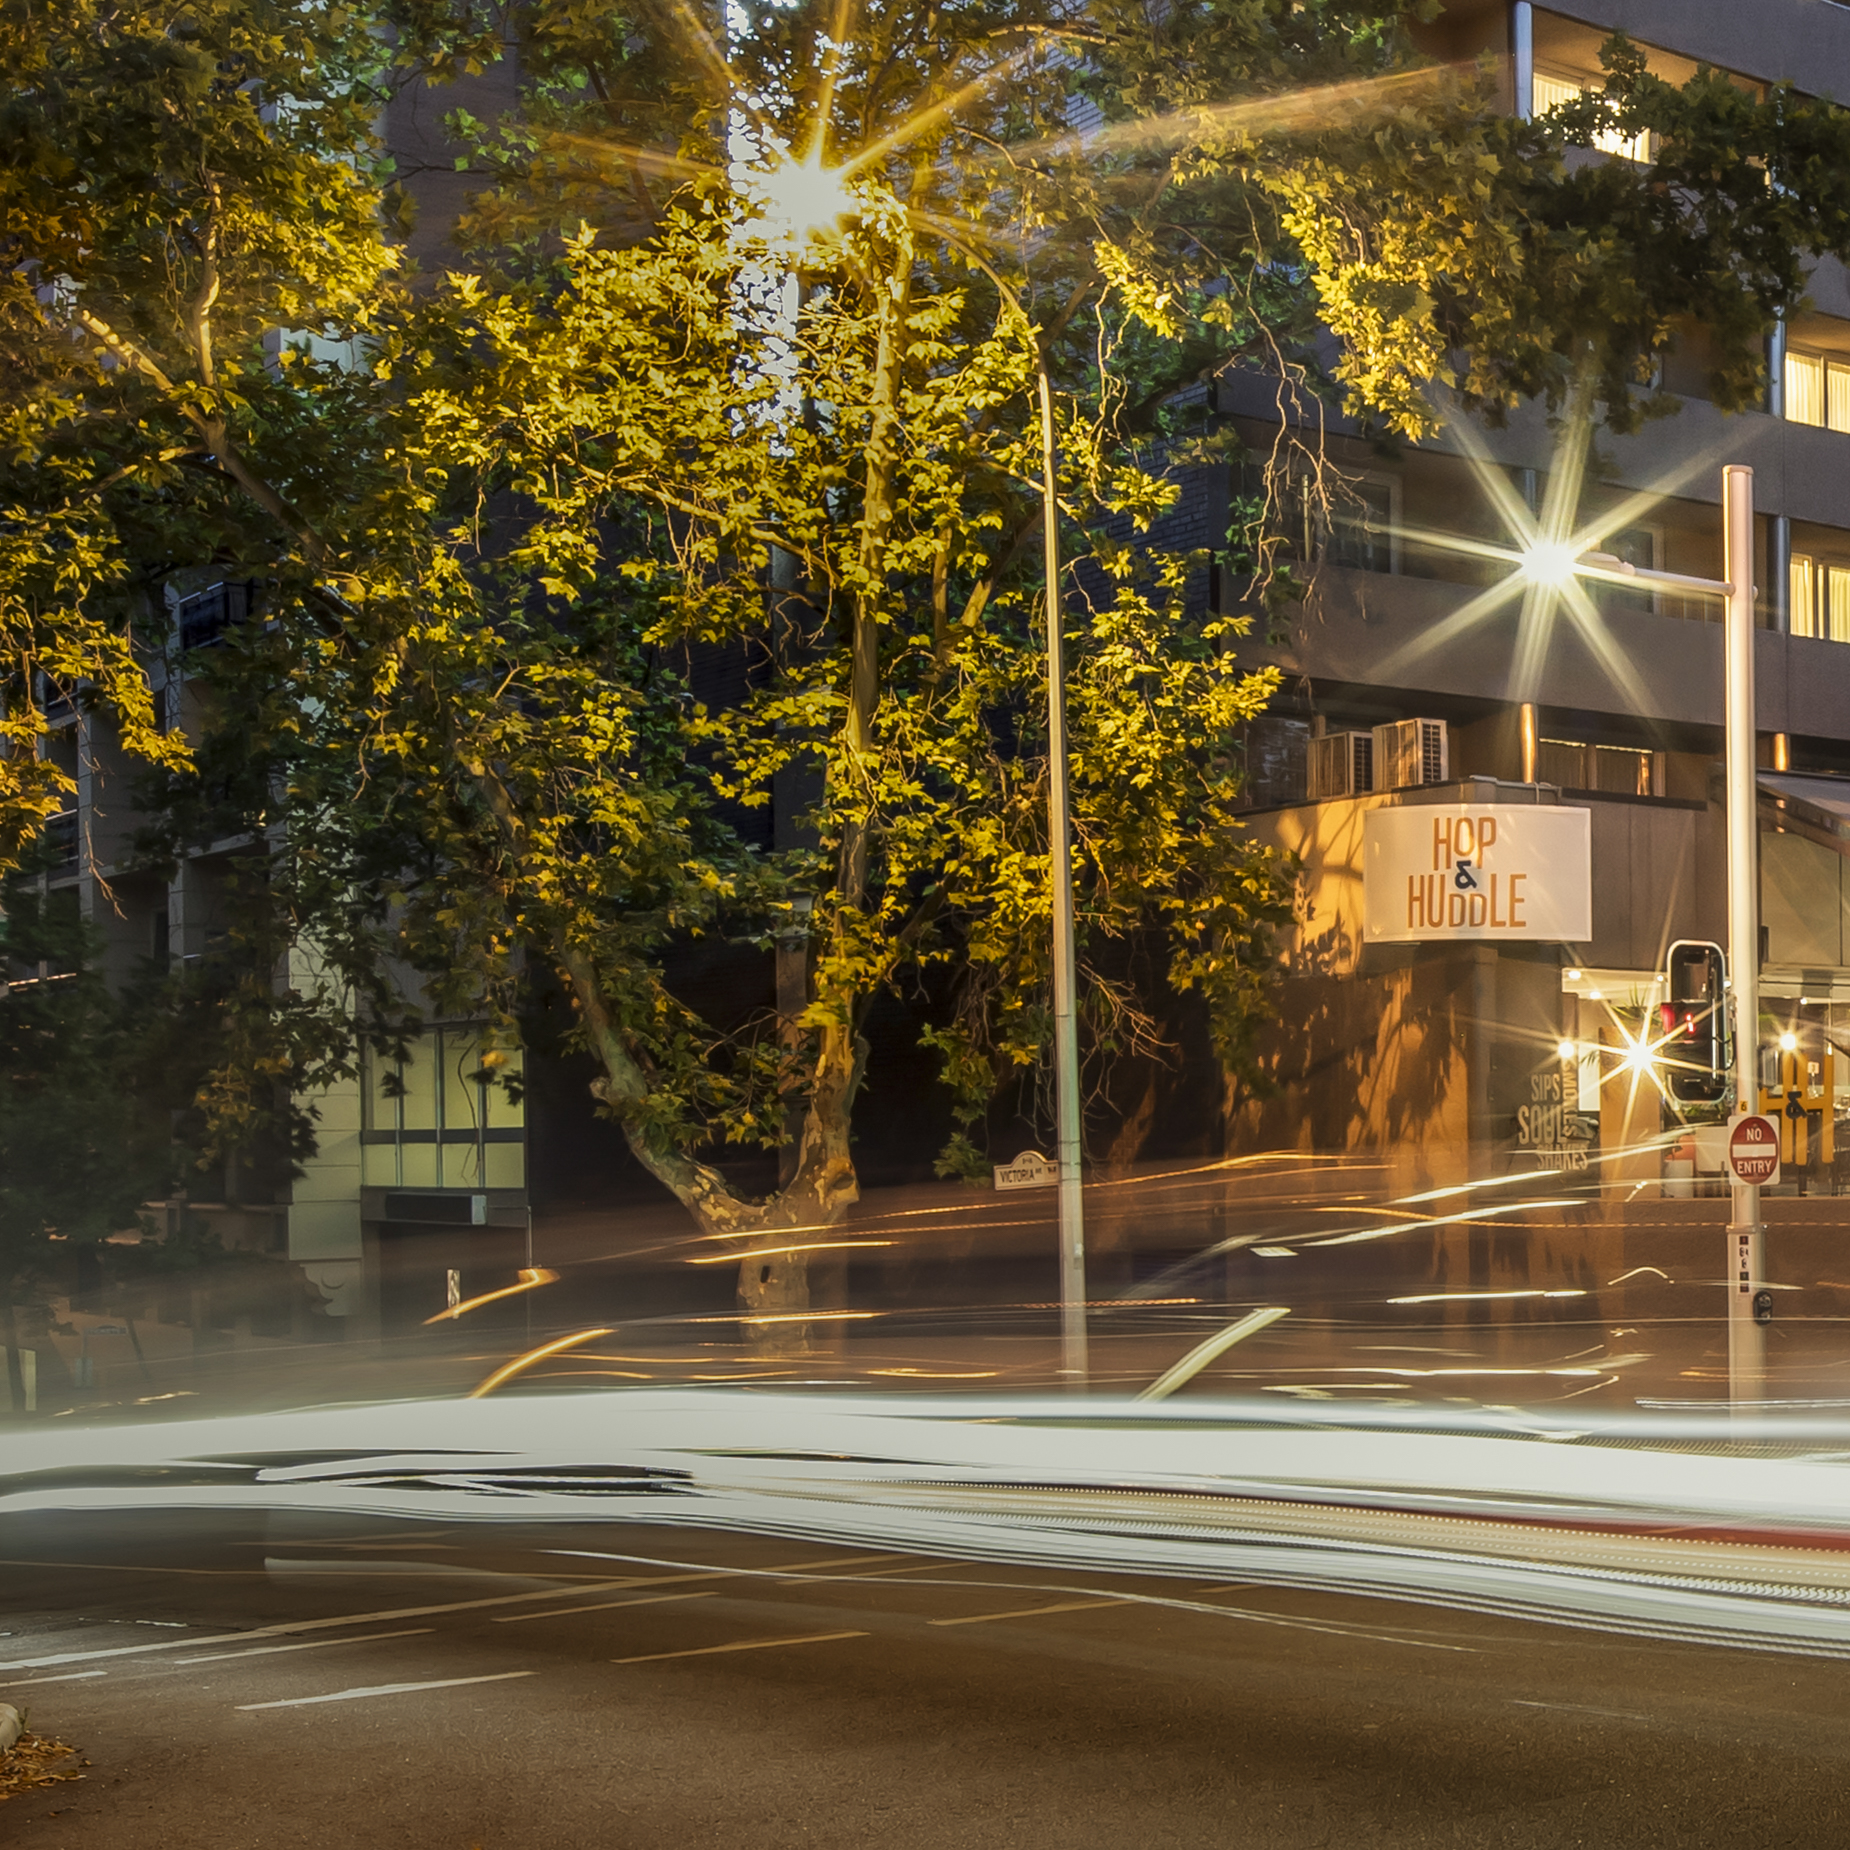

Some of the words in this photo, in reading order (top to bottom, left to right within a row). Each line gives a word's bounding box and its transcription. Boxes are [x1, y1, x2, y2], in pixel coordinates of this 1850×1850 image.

[1433, 817, 1497, 870] HOP
[1455, 860, 1477, 889] &
[1407, 873, 1527, 928] HUDDLE
[1531, 1073, 1560, 1101] SIPS
[1518, 1105, 1567, 1144] SOUL
[1746, 1127, 1763, 1141] NO
[1536, 1144, 1588, 1171] SHAKES
[1737, 1160, 1772, 1175] ENTRY
[999, 1169, 1035, 1184] VICTORIA
